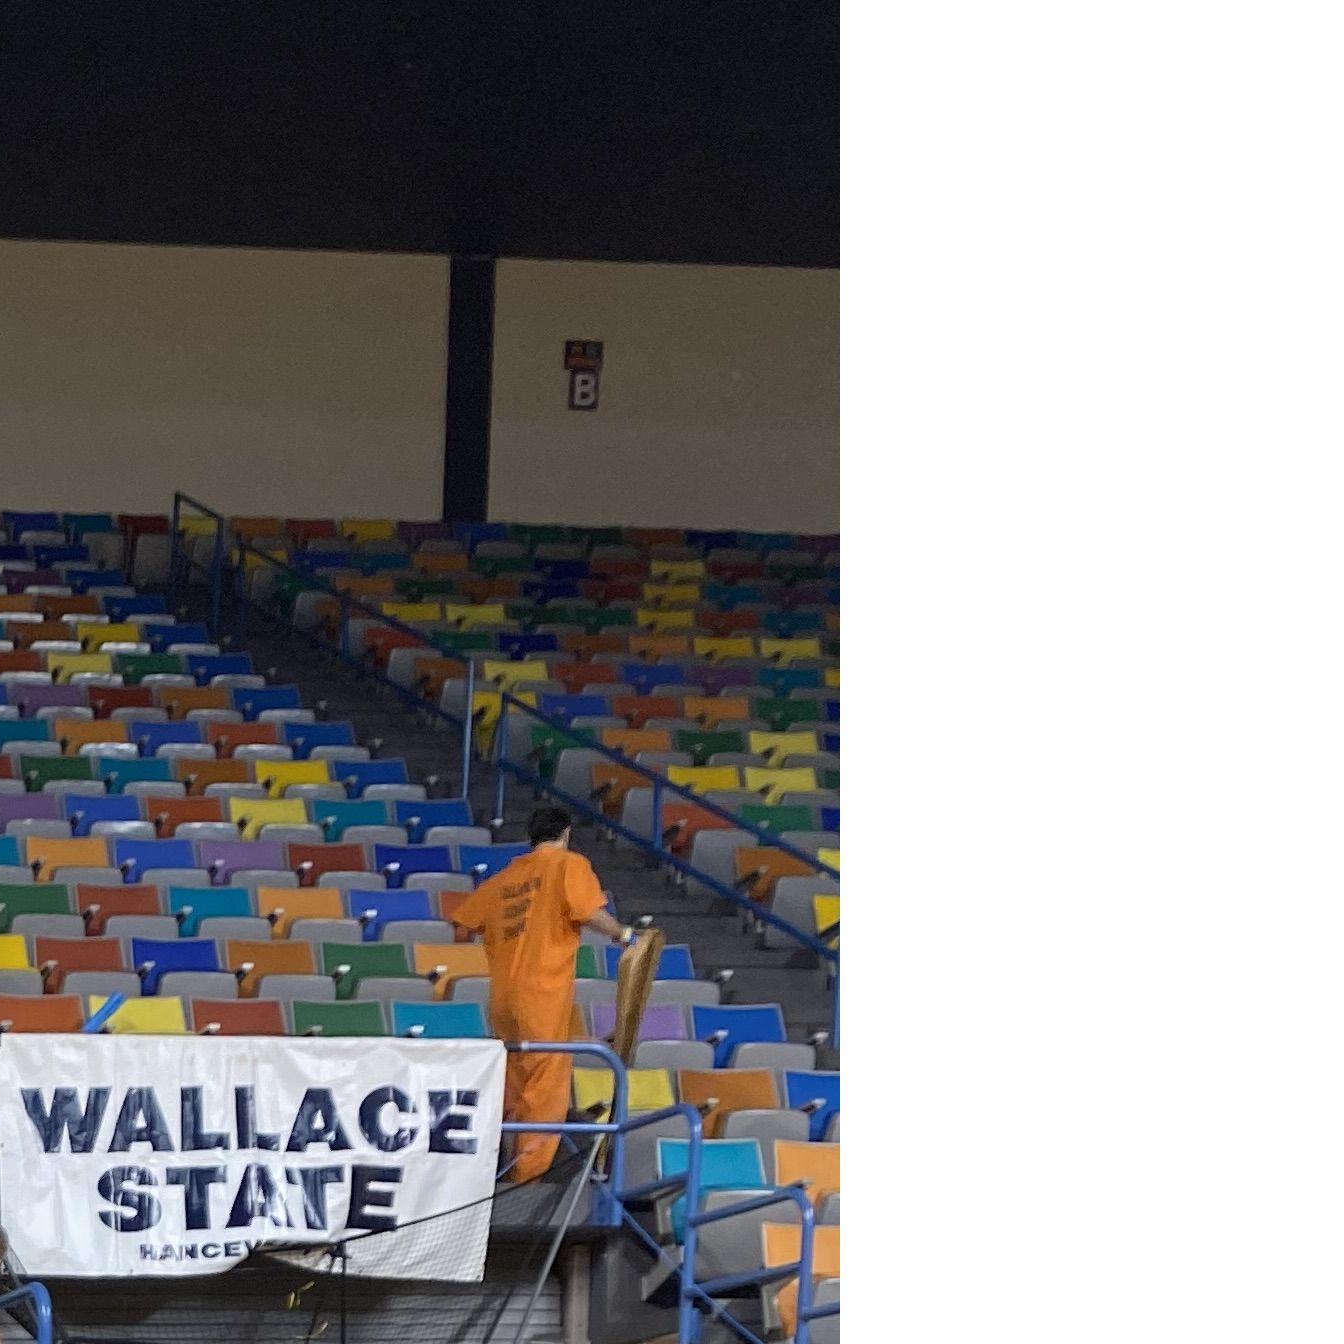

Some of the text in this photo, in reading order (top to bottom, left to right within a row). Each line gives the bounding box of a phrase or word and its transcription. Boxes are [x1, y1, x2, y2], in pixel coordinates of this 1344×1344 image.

[574, 373, 595, 406] B
[20, 1085, 482, 1155] WALLACE
[97, 1163, 406, 1233] STATE
[139, 1238, 287, 1262] HANCEV
